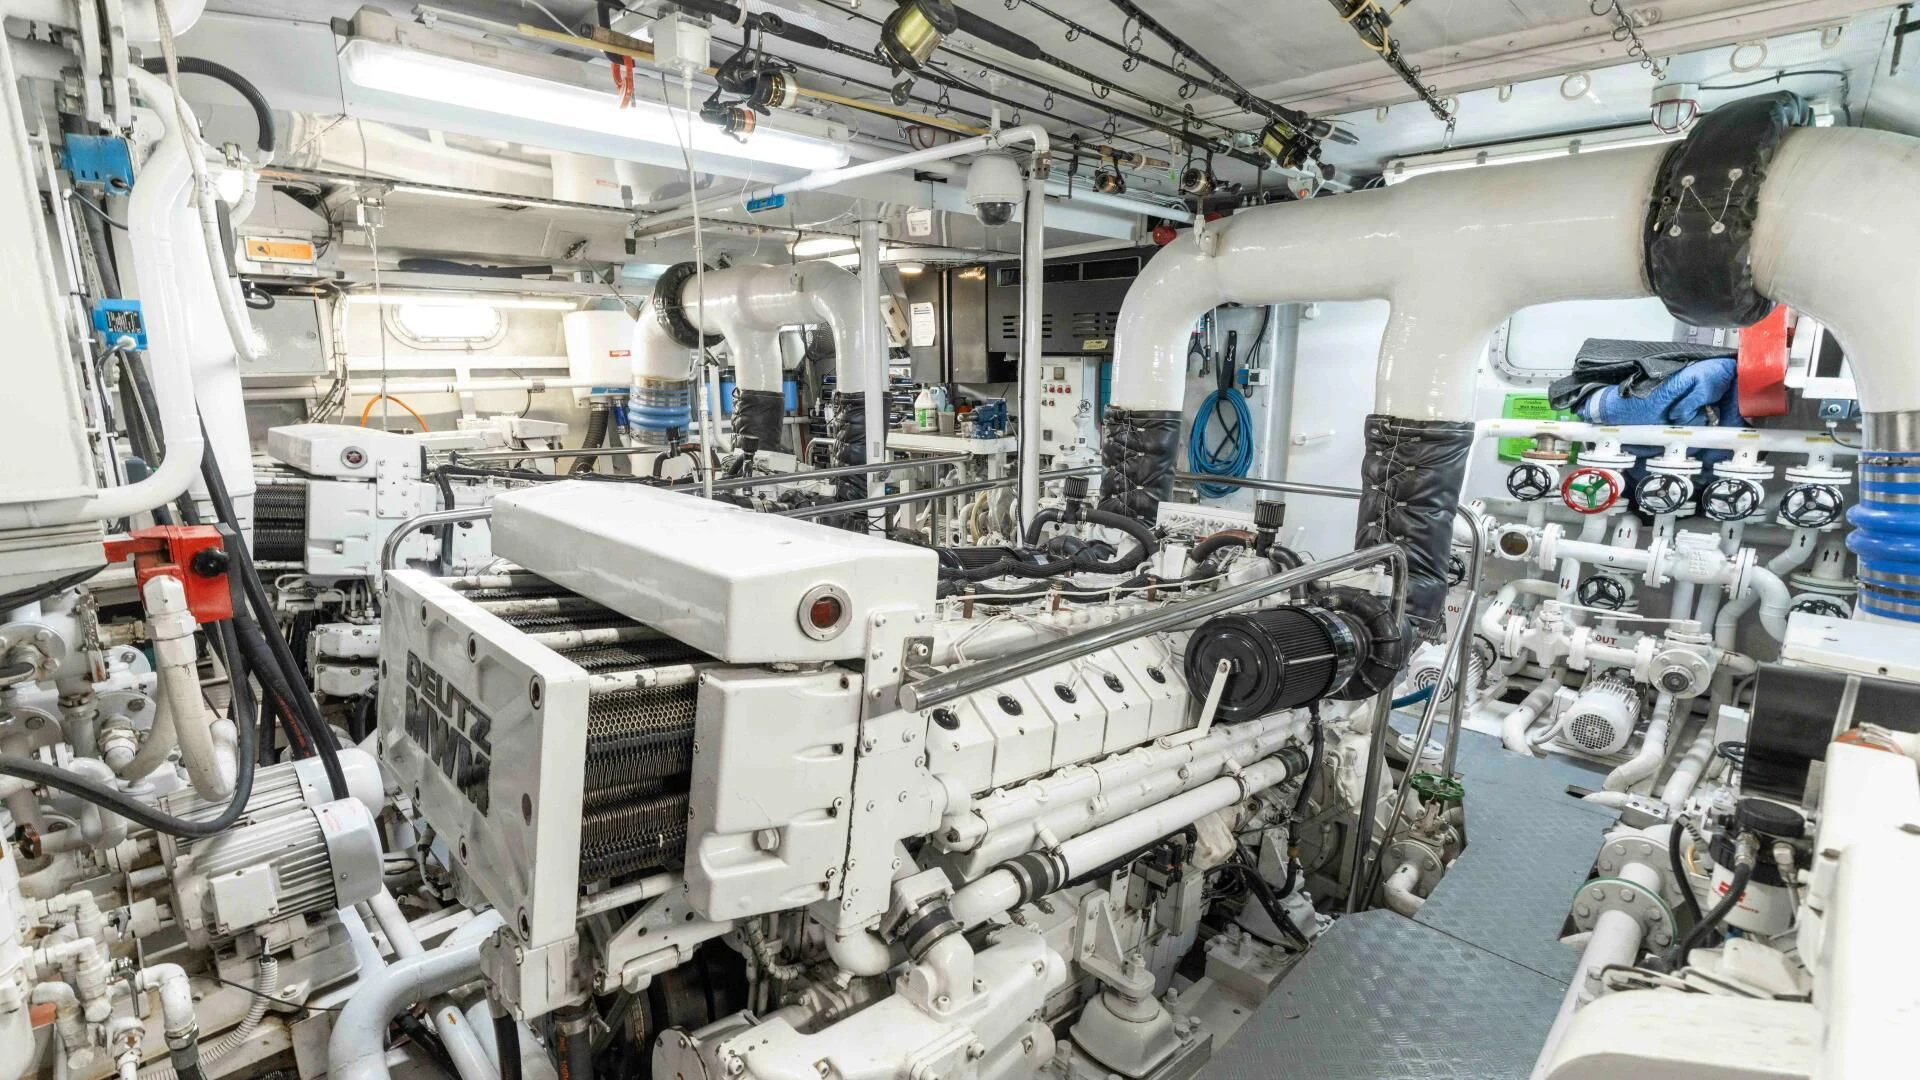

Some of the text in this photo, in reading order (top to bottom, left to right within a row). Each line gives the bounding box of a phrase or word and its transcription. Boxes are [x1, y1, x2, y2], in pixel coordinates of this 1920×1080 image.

[1447, 605, 1462, 613] OU
[1595, 634, 1618, 645] OUT
[406, 649, 491, 756] DEUTZ
